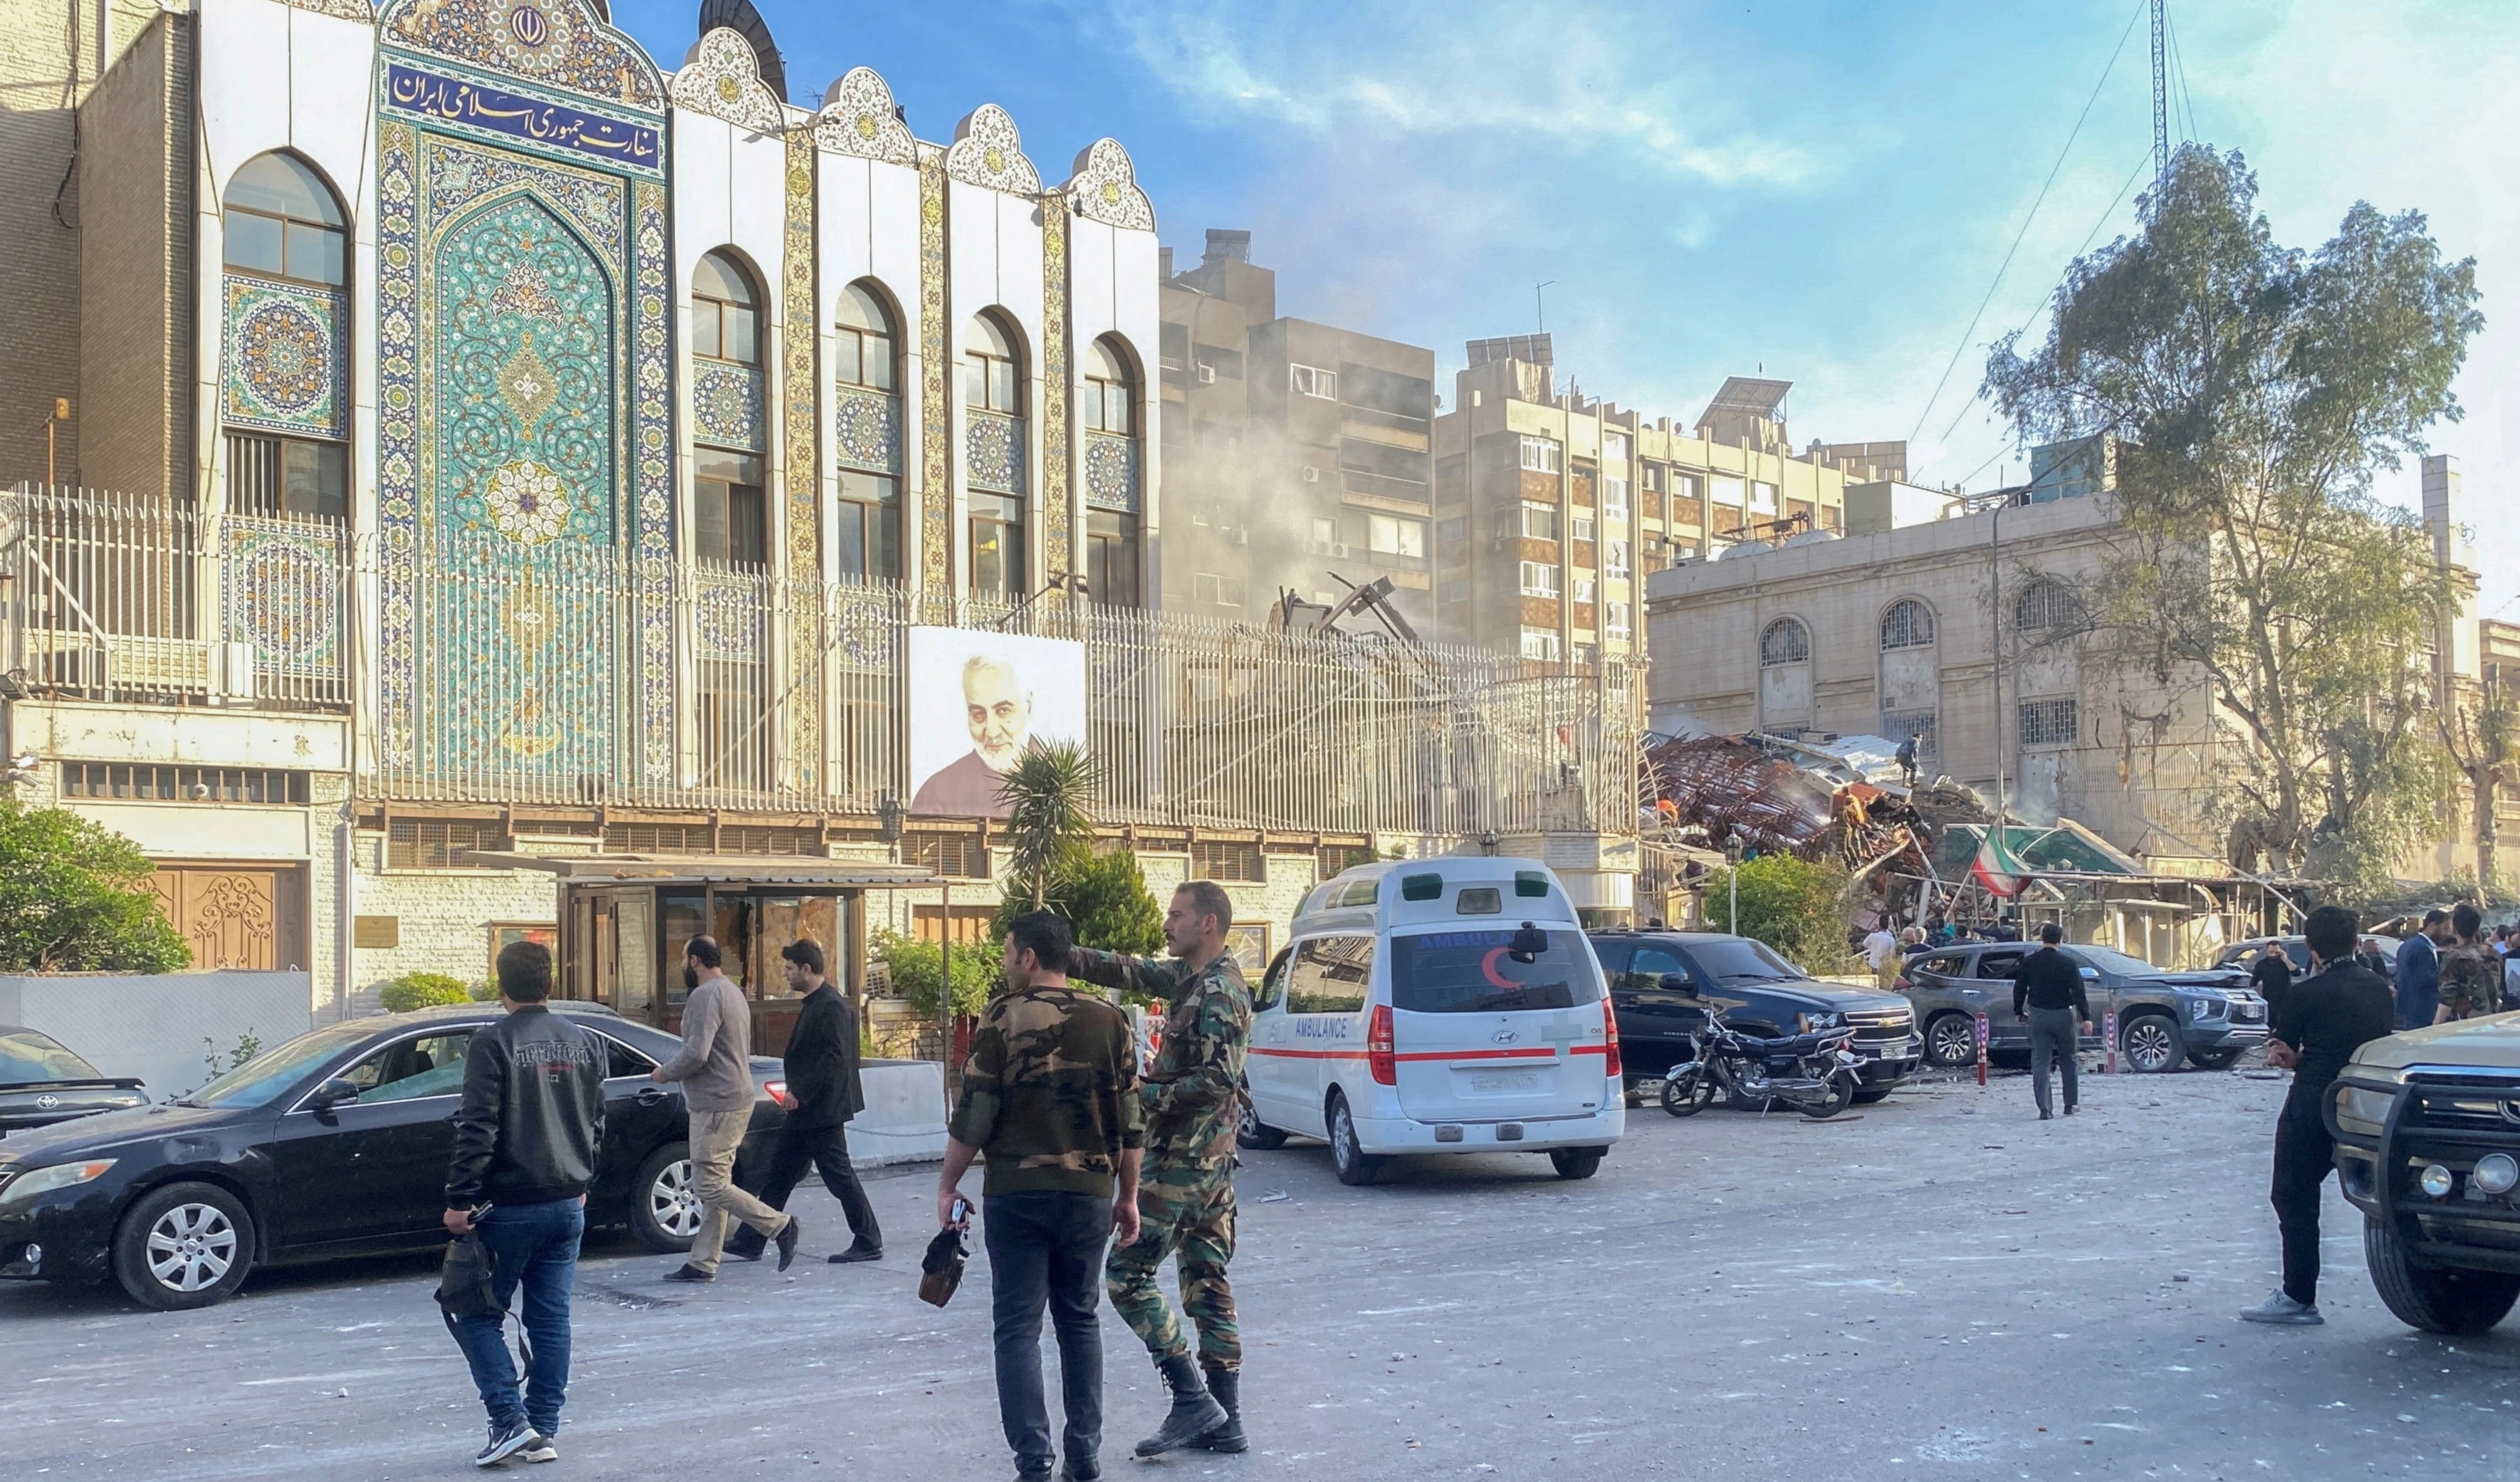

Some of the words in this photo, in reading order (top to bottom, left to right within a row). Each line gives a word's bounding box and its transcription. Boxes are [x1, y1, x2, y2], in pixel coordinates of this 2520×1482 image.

[394, 75, 444, 116] ایران
[441, 85, 533, 131] اسلامی
[530, 108, 585, 147] جمهوری
[579, 125, 654, 156] سفارت
[1295, 1017, 1347, 1038] AMBULANCE
